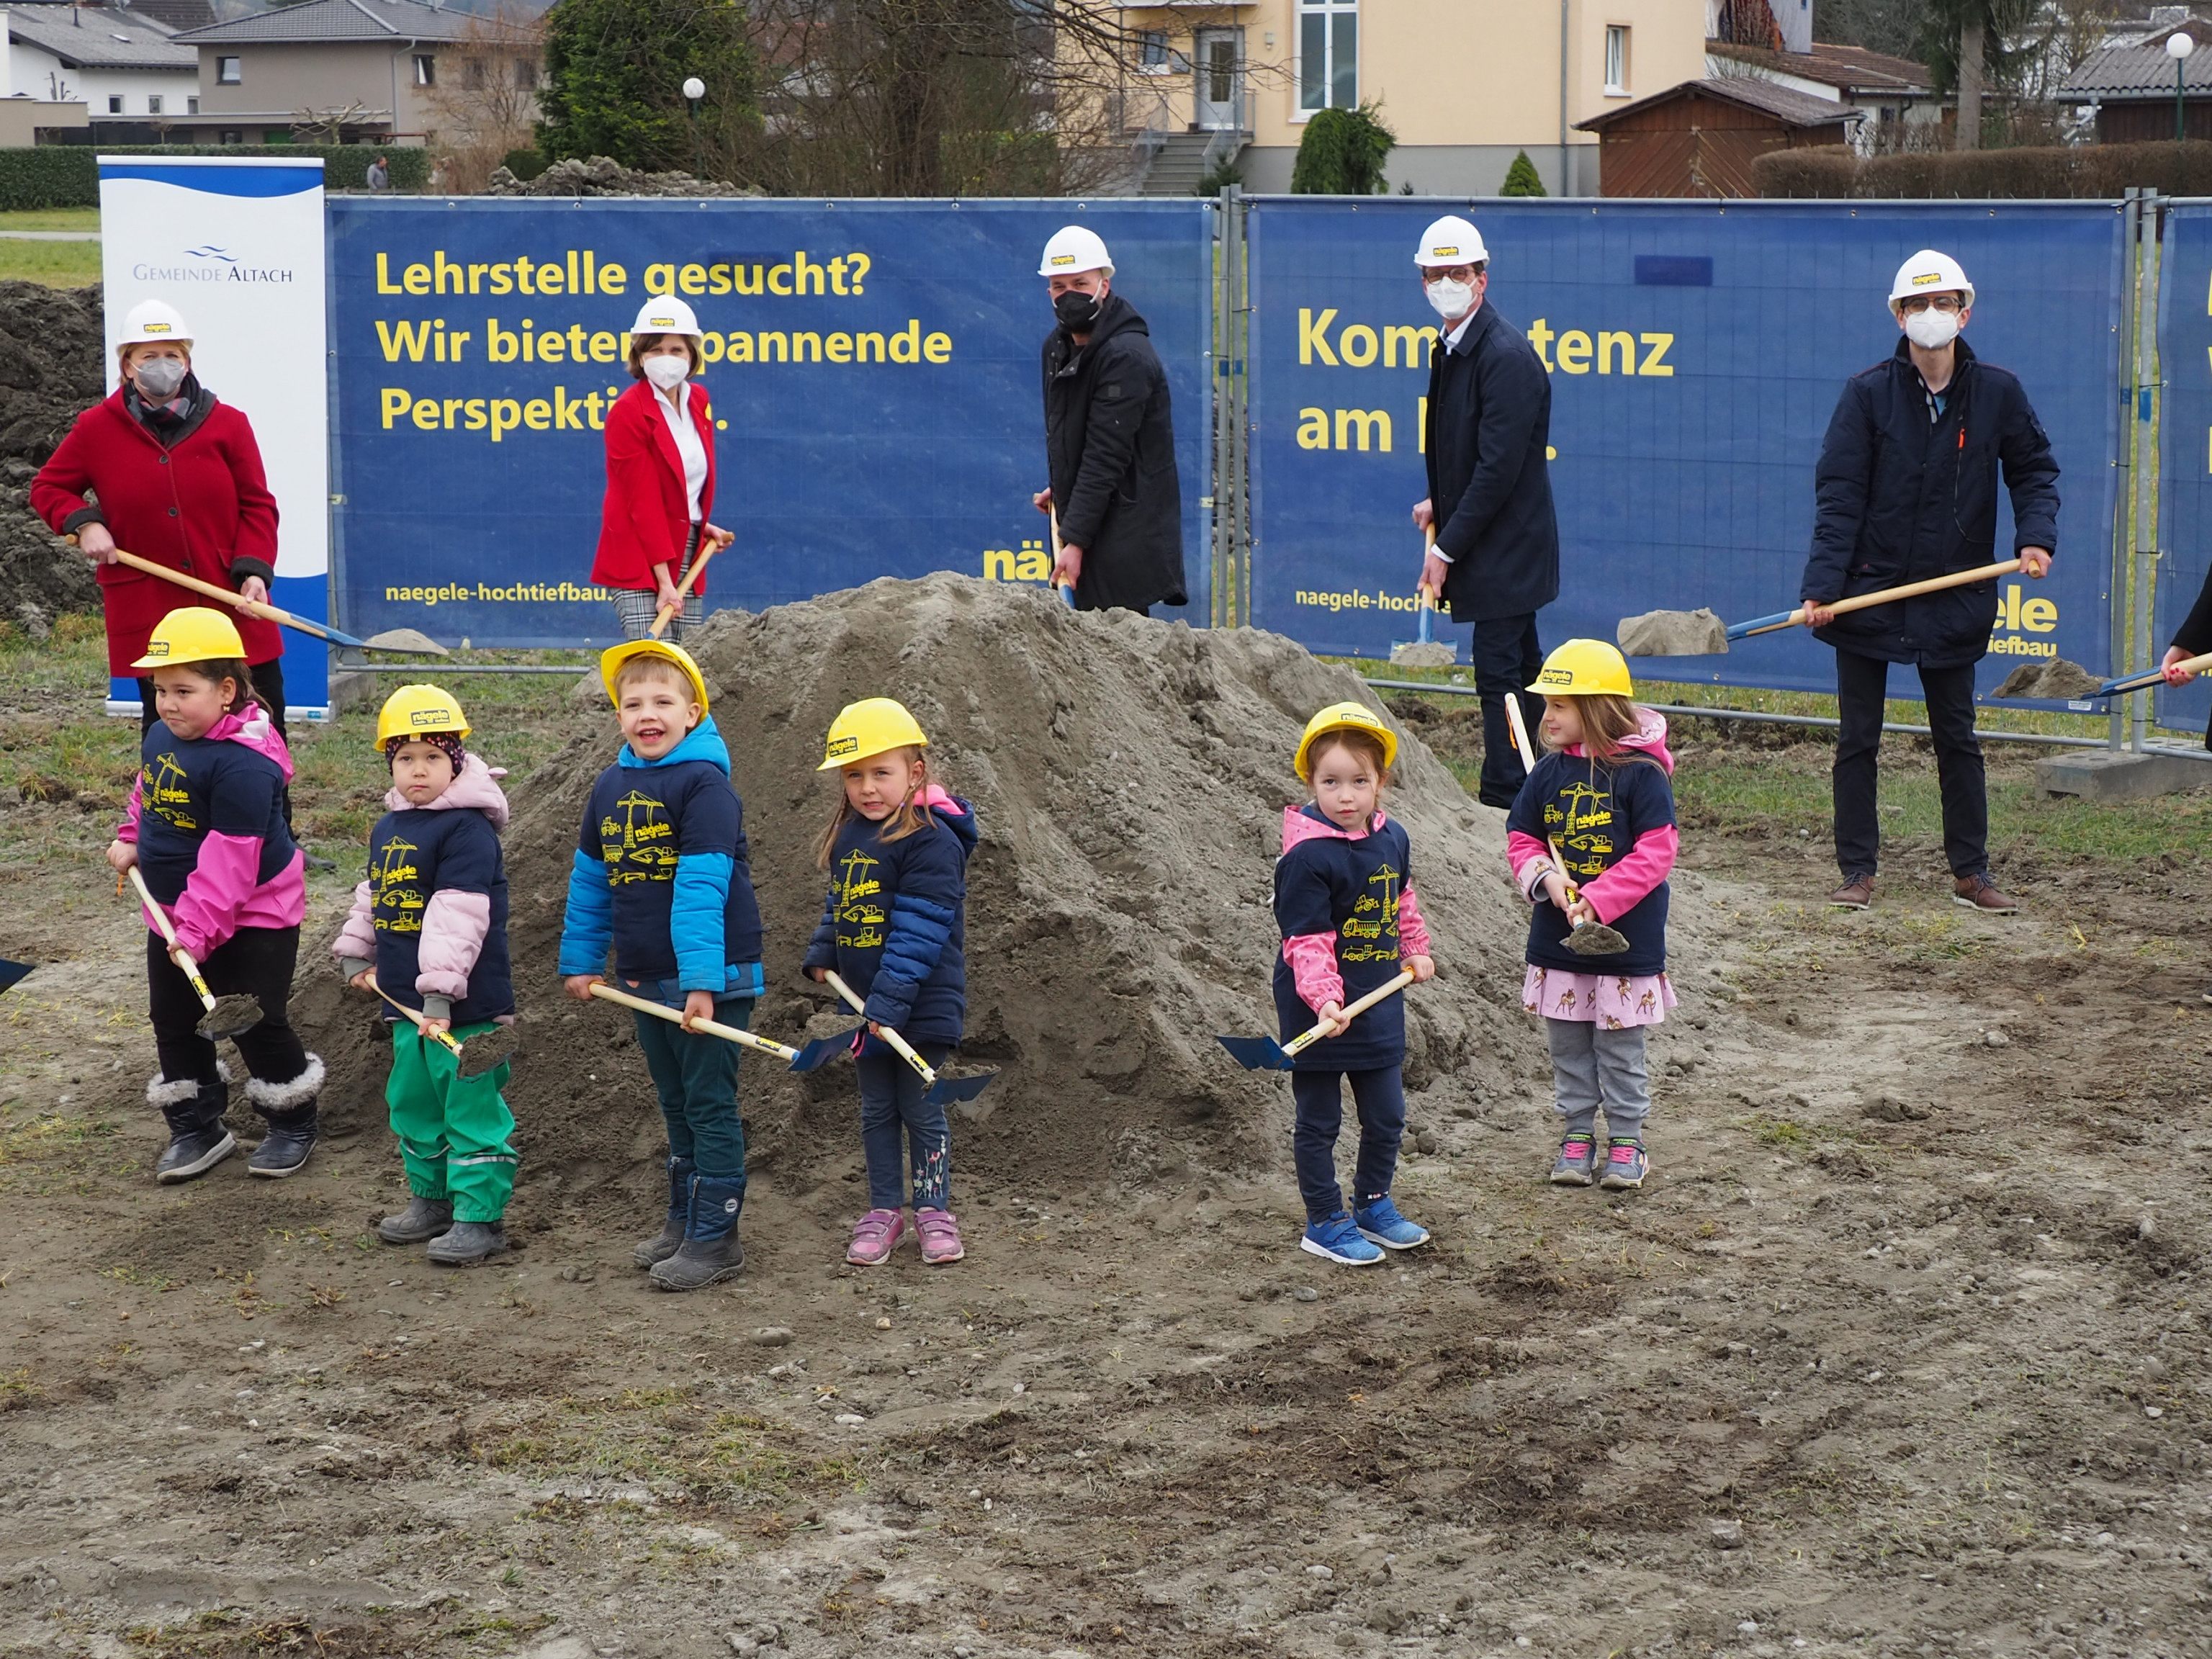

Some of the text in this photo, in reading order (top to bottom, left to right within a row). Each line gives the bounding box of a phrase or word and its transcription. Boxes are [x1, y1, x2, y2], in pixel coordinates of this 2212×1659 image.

[133, 264, 292, 282] GEMEINDE ALTACH
[376, 251, 871, 301] Lehrstelle gesucht?
[374, 318, 470, 361] Wir
[696, 319, 952, 374] pannende
[1298, 308, 1674, 376] Komtenz
[1296, 405, 1392, 451] am
[385, 582, 613, 606] naegele-hochtiefbau.
[634, 822, 670, 839] nägele
